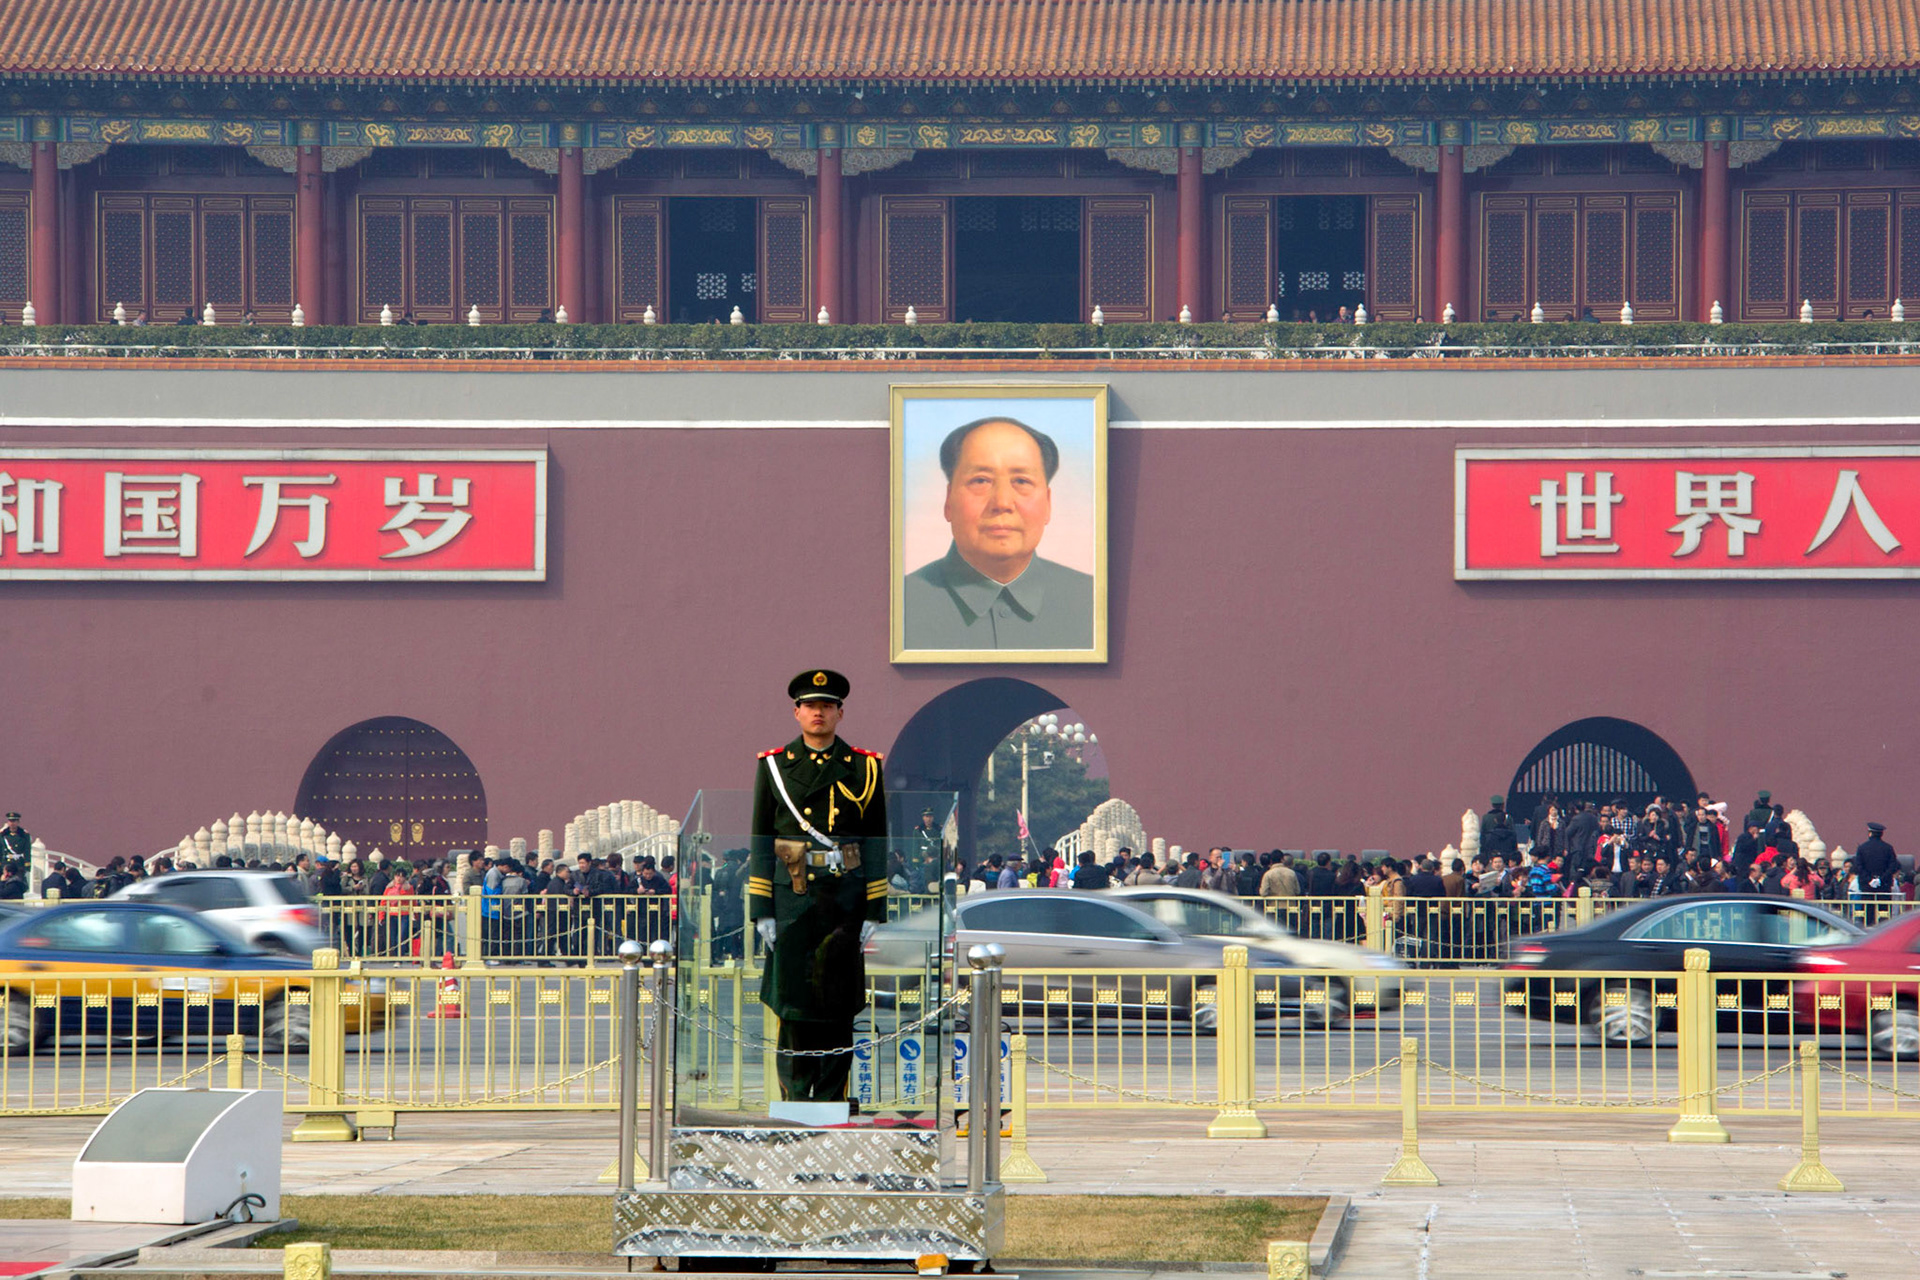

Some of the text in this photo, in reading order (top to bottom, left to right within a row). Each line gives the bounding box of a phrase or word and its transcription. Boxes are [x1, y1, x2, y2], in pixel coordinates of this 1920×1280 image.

[0, 471, 473, 559] 和国万岁
[1530, 469, 1902, 558] 世界人
[857, 1061, 873, 1103] 车辆右行
